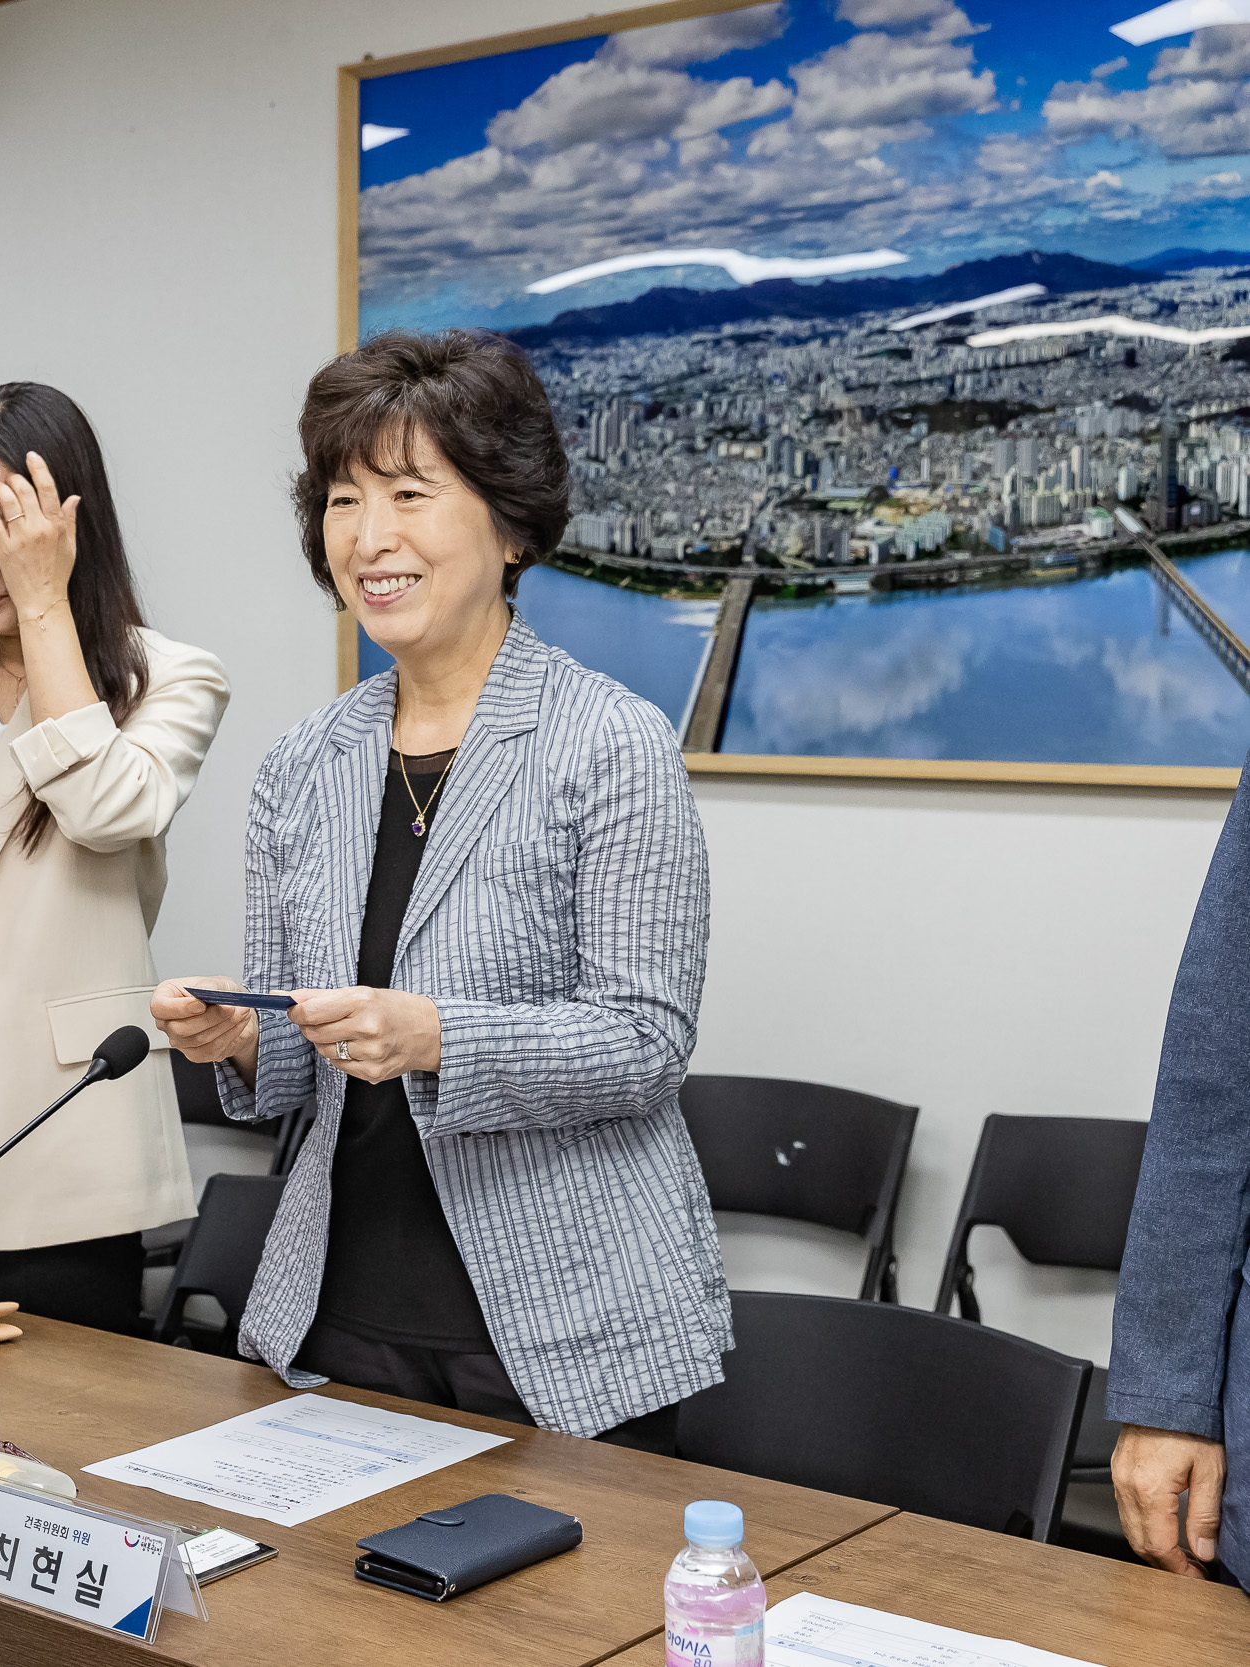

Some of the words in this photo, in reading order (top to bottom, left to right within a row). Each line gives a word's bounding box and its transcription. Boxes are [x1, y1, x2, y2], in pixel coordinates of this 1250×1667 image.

[24, 1515, 70, 1540] 건축위원회
[72, 1529, 91, 1546] 위원
[667, 1630, 712, 1657] 아이시스
